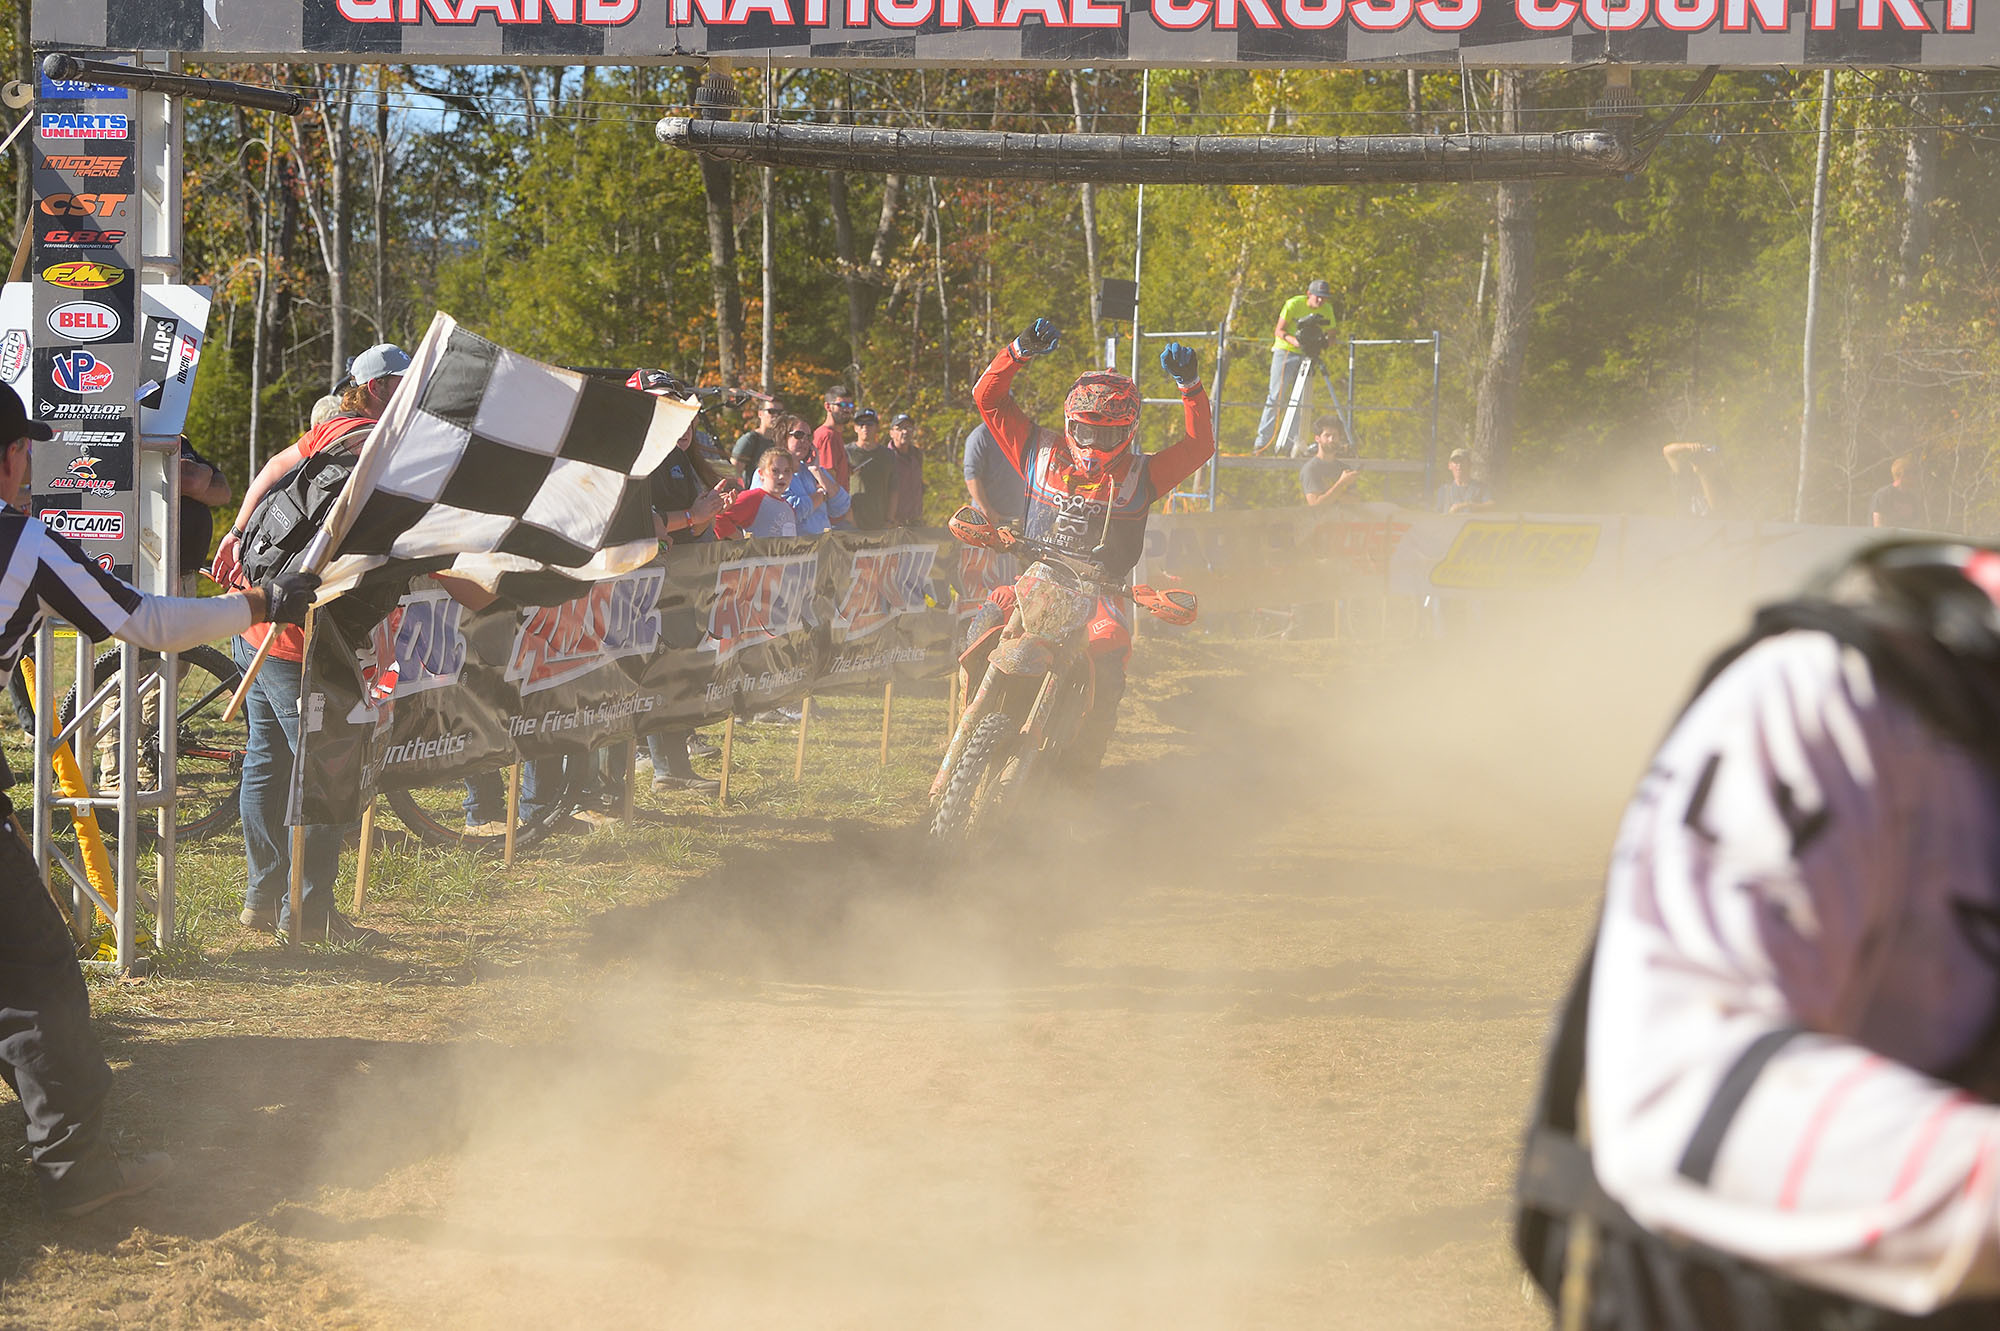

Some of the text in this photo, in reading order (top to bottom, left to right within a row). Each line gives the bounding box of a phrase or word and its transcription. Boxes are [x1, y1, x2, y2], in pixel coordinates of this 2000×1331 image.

[41, 114, 127, 128] PARTS
[42, 128, 127, 138] UNLIMITED
[42, 156, 127, 169] MOOSE
[74, 169, 119, 177] RACING
[41, 193, 127, 217] CST
[44, 230, 124, 243] GBC
[44, 265, 124, 282] FMF
[59, 312, 109, 328] BELL
[151, 320, 174, 362] LAPS
[54, 352, 95, 391] VP
[56, 404, 126, 413] DUNLOP
[63, 431, 126, 442] WISECO
[50, 479, 116, 489] ALL BALLS
[504, 567, 666, 697] AMSOIL
[508, 694, 655, 737] The First in Synthetics
